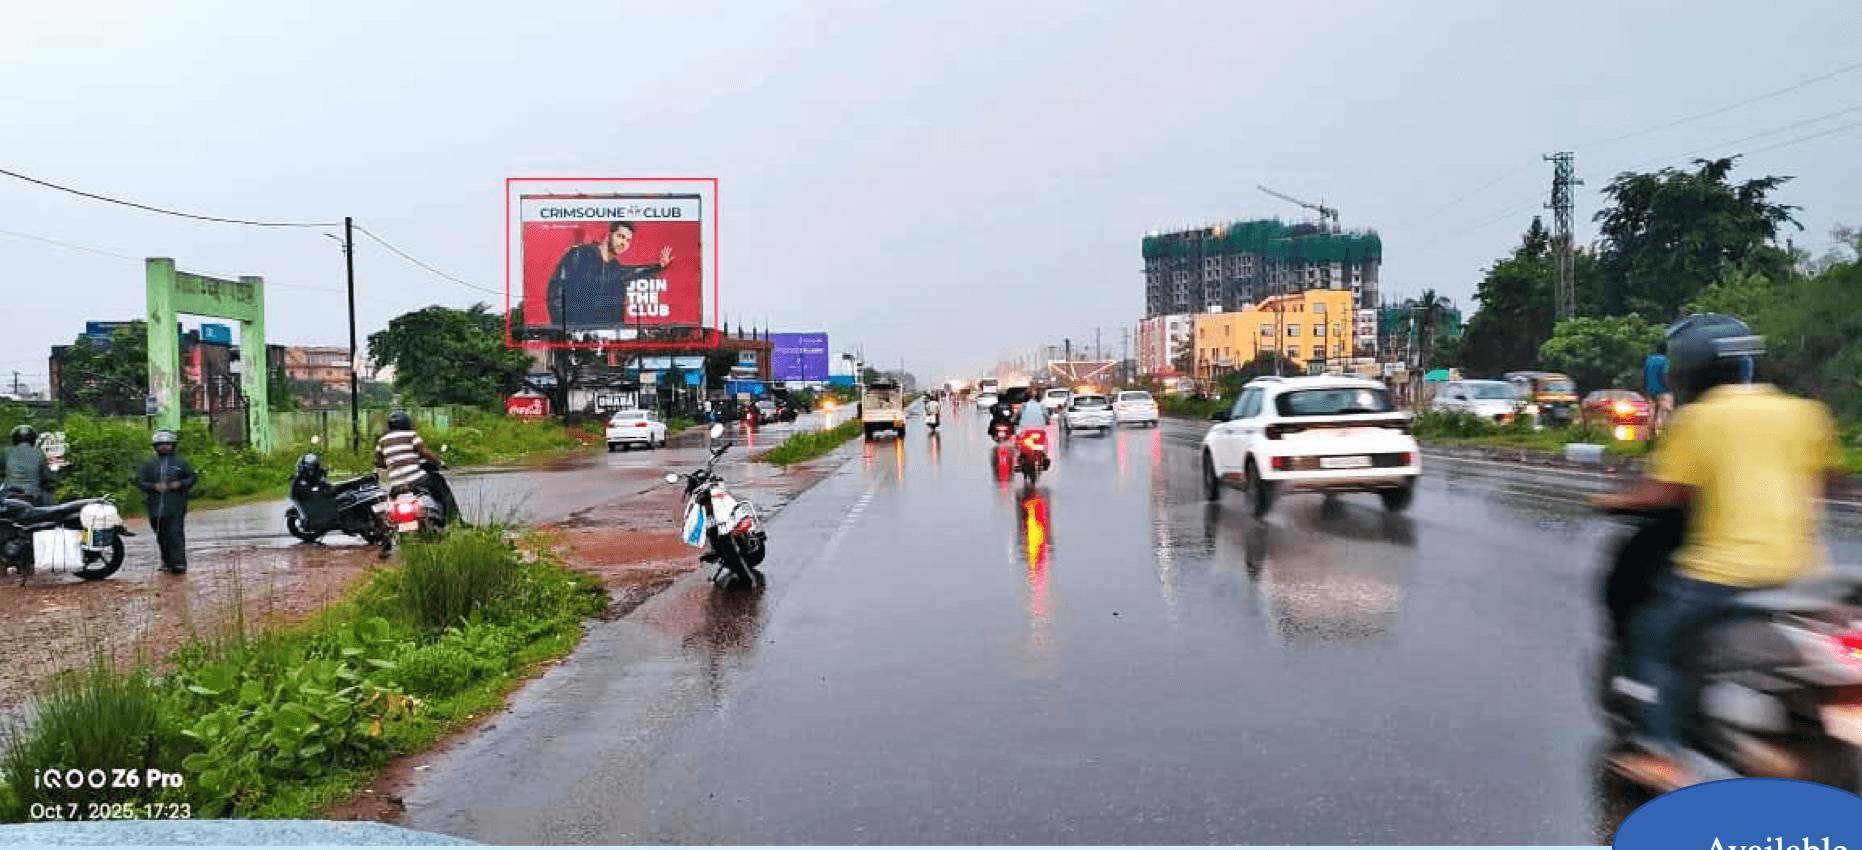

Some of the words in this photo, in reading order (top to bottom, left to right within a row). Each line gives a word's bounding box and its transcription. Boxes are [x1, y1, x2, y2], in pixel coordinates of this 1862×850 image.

[540, 207, 625, 218] CRIMSOUNE
[643, 207, 682, 218] CLUB
[626, 279, 668, 291] JOIN
[627, 291, 659, 303] THE
[627, 303, 670, 316] CLUB
